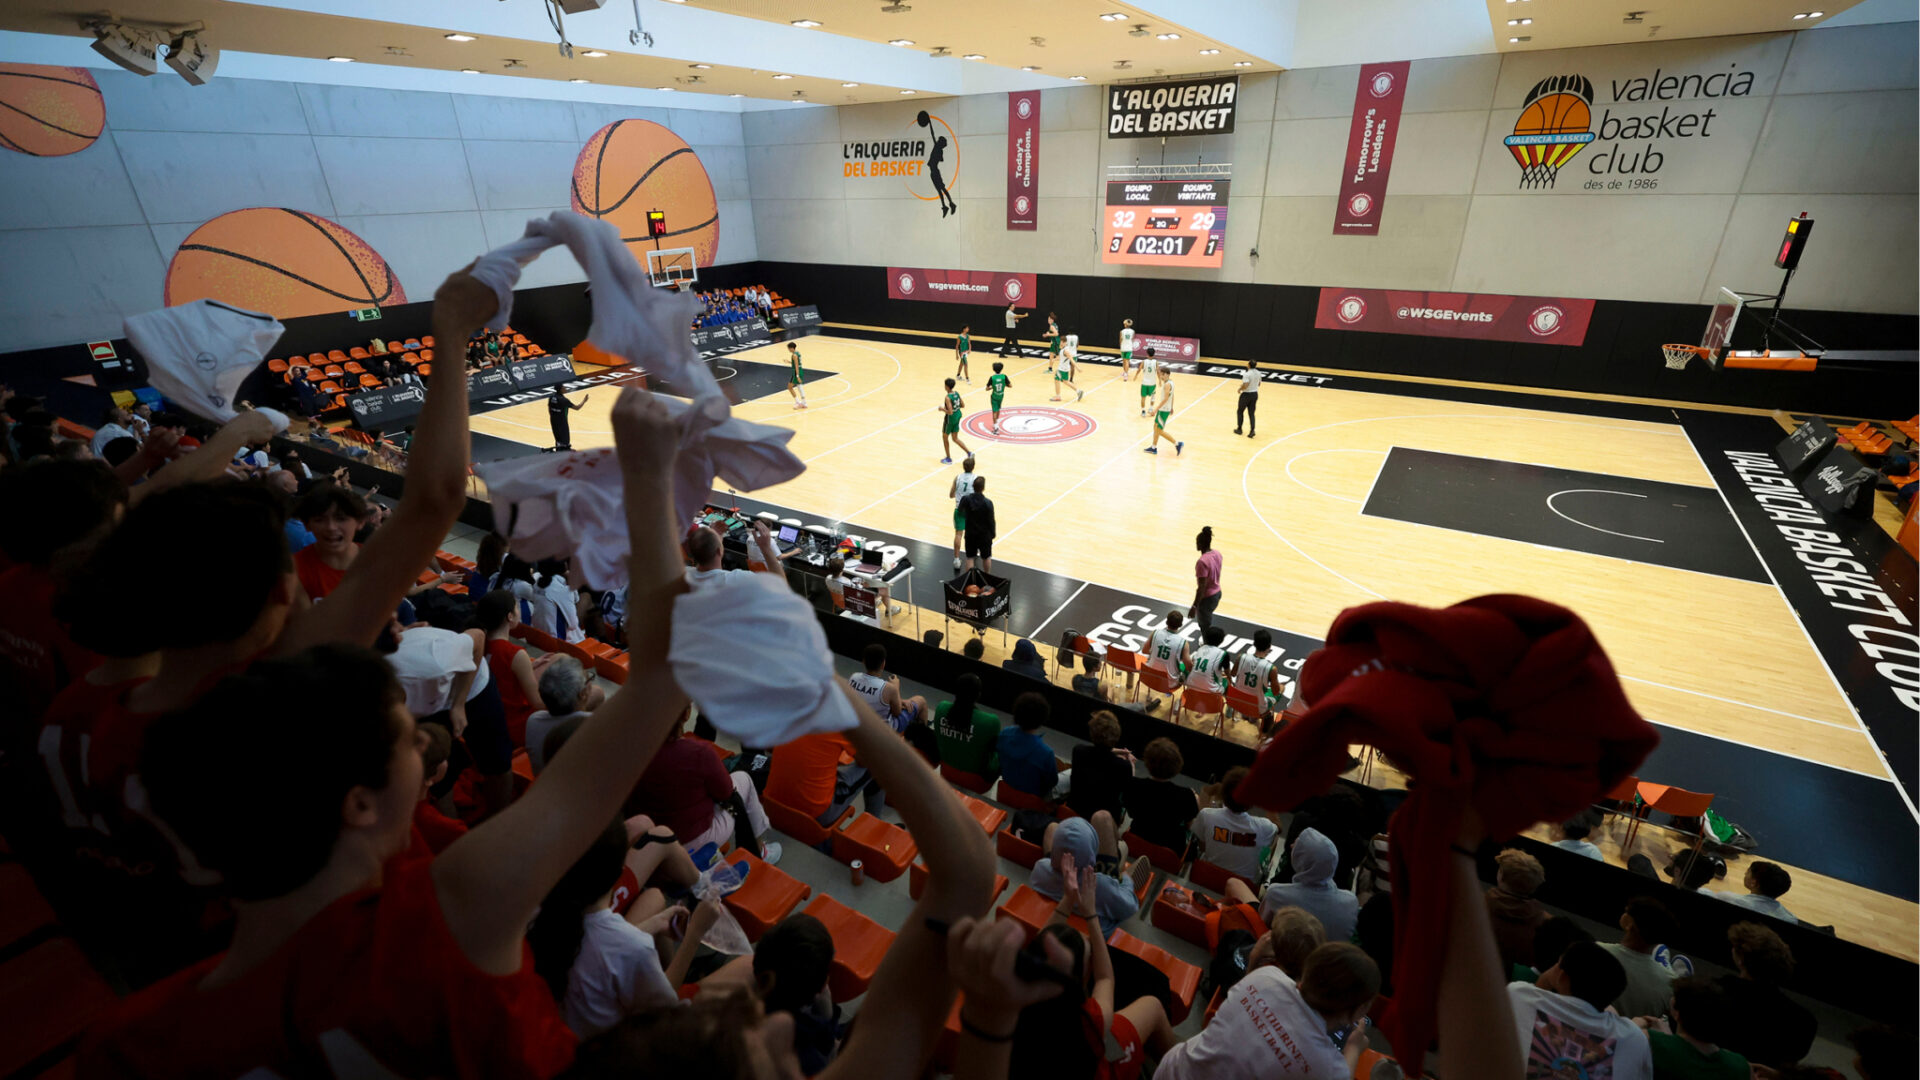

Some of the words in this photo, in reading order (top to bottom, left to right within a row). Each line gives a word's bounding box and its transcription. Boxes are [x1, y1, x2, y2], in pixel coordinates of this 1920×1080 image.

[1612, 63, 1755, 102] valencia
[1112, 82, 1236, 112] L'ALQUERIA
[1109, 113, 1144, 134] DEL
[1148, 108, 1232, 133] BASKET
[1598, 106, 1717, 141] basket
[1354, 108, 1376, 183] Tomorrow's
[1368, 119, 1387, 173] Leaders.
[1509, 135, 1553, 144] VALENCIA
[1555, 133, 1591, 143] BASKET
[843, 140, 926, 160] L'ALQUERIA
[1015, 137, 1023, 179] Today's
[1023, 128, 1032, 188] Champions.
[1588, 143, 1664, 174] club
[843, 161, 867, 178] DEL
[870, 160, 925, 177] BASKET
[1125, 184, 1153, 192] EQUIPO
[1182, 184, 1213, 192] EQUIPO
[1583, 179, 1604, 190] des
[1607, 179, 1622, 190] de
[1627, 178, 1658, 190] 1986
[1125, 193, 1151, 201] LOCAL
[1177, 192, 1217, 201] VISITANTE
[655, 222, 665, 234] 14
[1112, 211, 1136, 228] 32
[1189, 212, 1216, 231] 29
[1110, 239, 1120, 251] 3
[1135, 237, 1183, 254] 02:01
[1207, 241, 1215, 255] 1
[928, 282, 990, 293] wsgevents.com
[1396, 306, 1493, 323] @WSGEvents
[962, 482, 969, 492] 7
[1723, 450, 1828, 525] VALENCIA
[1776, 524, 1913, 627] BASKET
[947, 600, 979, 618] SPALDING
[1157, 645, 1171, 660] 15
[1194, 657, 1209, 673] 14
[849, 679, 879, 696] TALAAT
[1244, 671, 1258, 688] 13
[1240, 996, 1293, 1073] BASKETBALL
[1255, 998, 1313, 1074] CATHERINE'S
